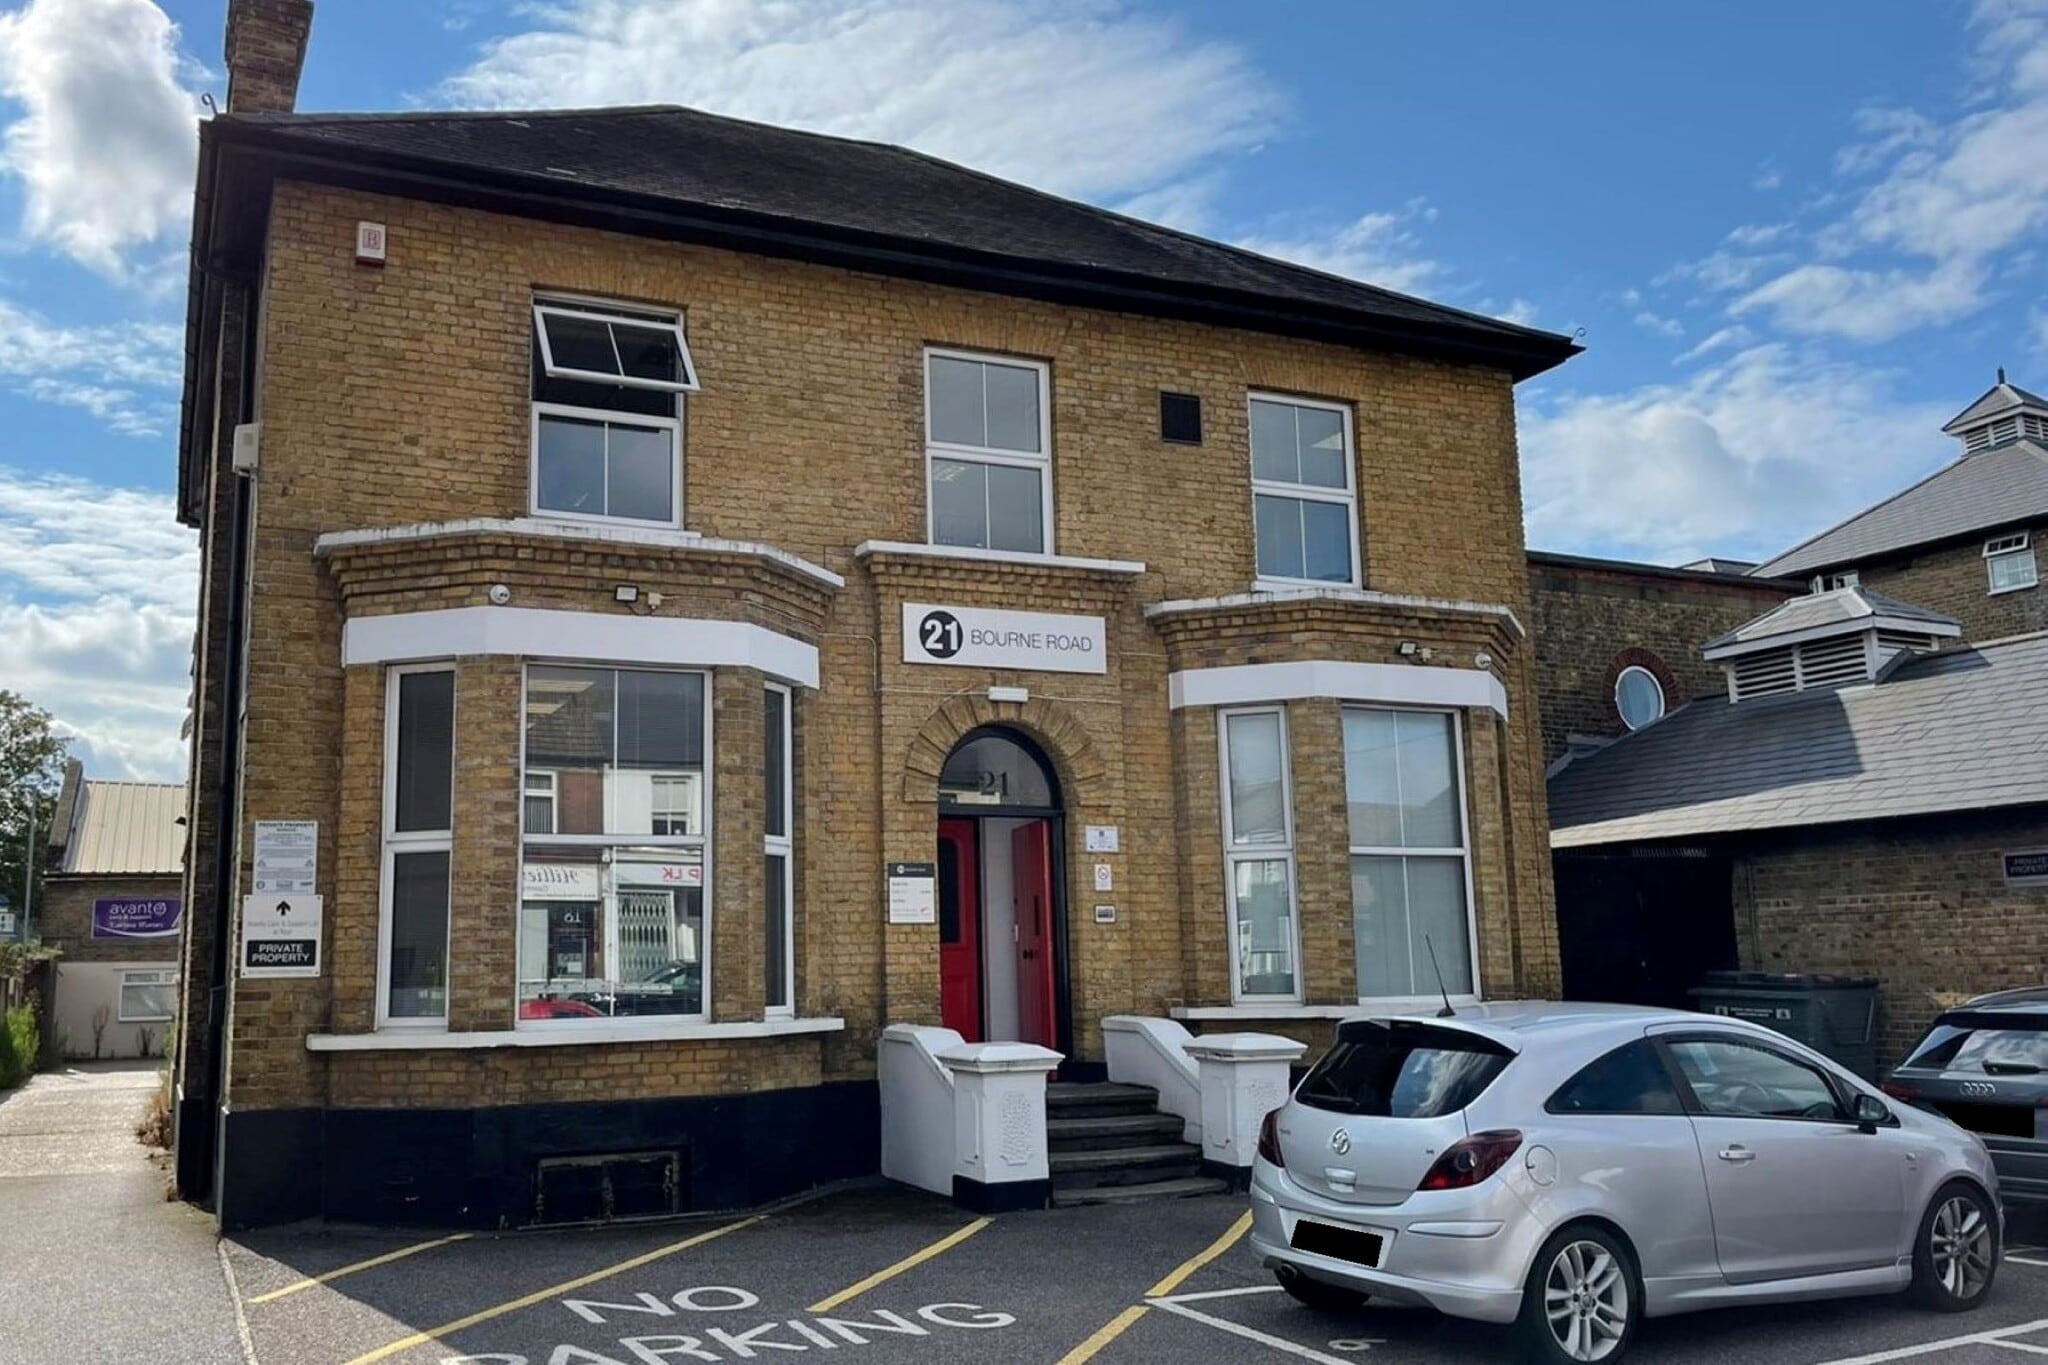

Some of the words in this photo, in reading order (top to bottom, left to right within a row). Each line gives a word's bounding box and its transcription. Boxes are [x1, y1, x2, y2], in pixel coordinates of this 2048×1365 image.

[924, 618, 959, 651] 21
[970, 628, 1042, 650] BOURNE
[1046, 634, 1093, 652] ROAD
[979, 771, 1009, 796] 21
[252, 952, 310, 963] PROPERTY
[259, 943, 304, 953] PRIVATE
[562, 1286, 760, 1323] NO
